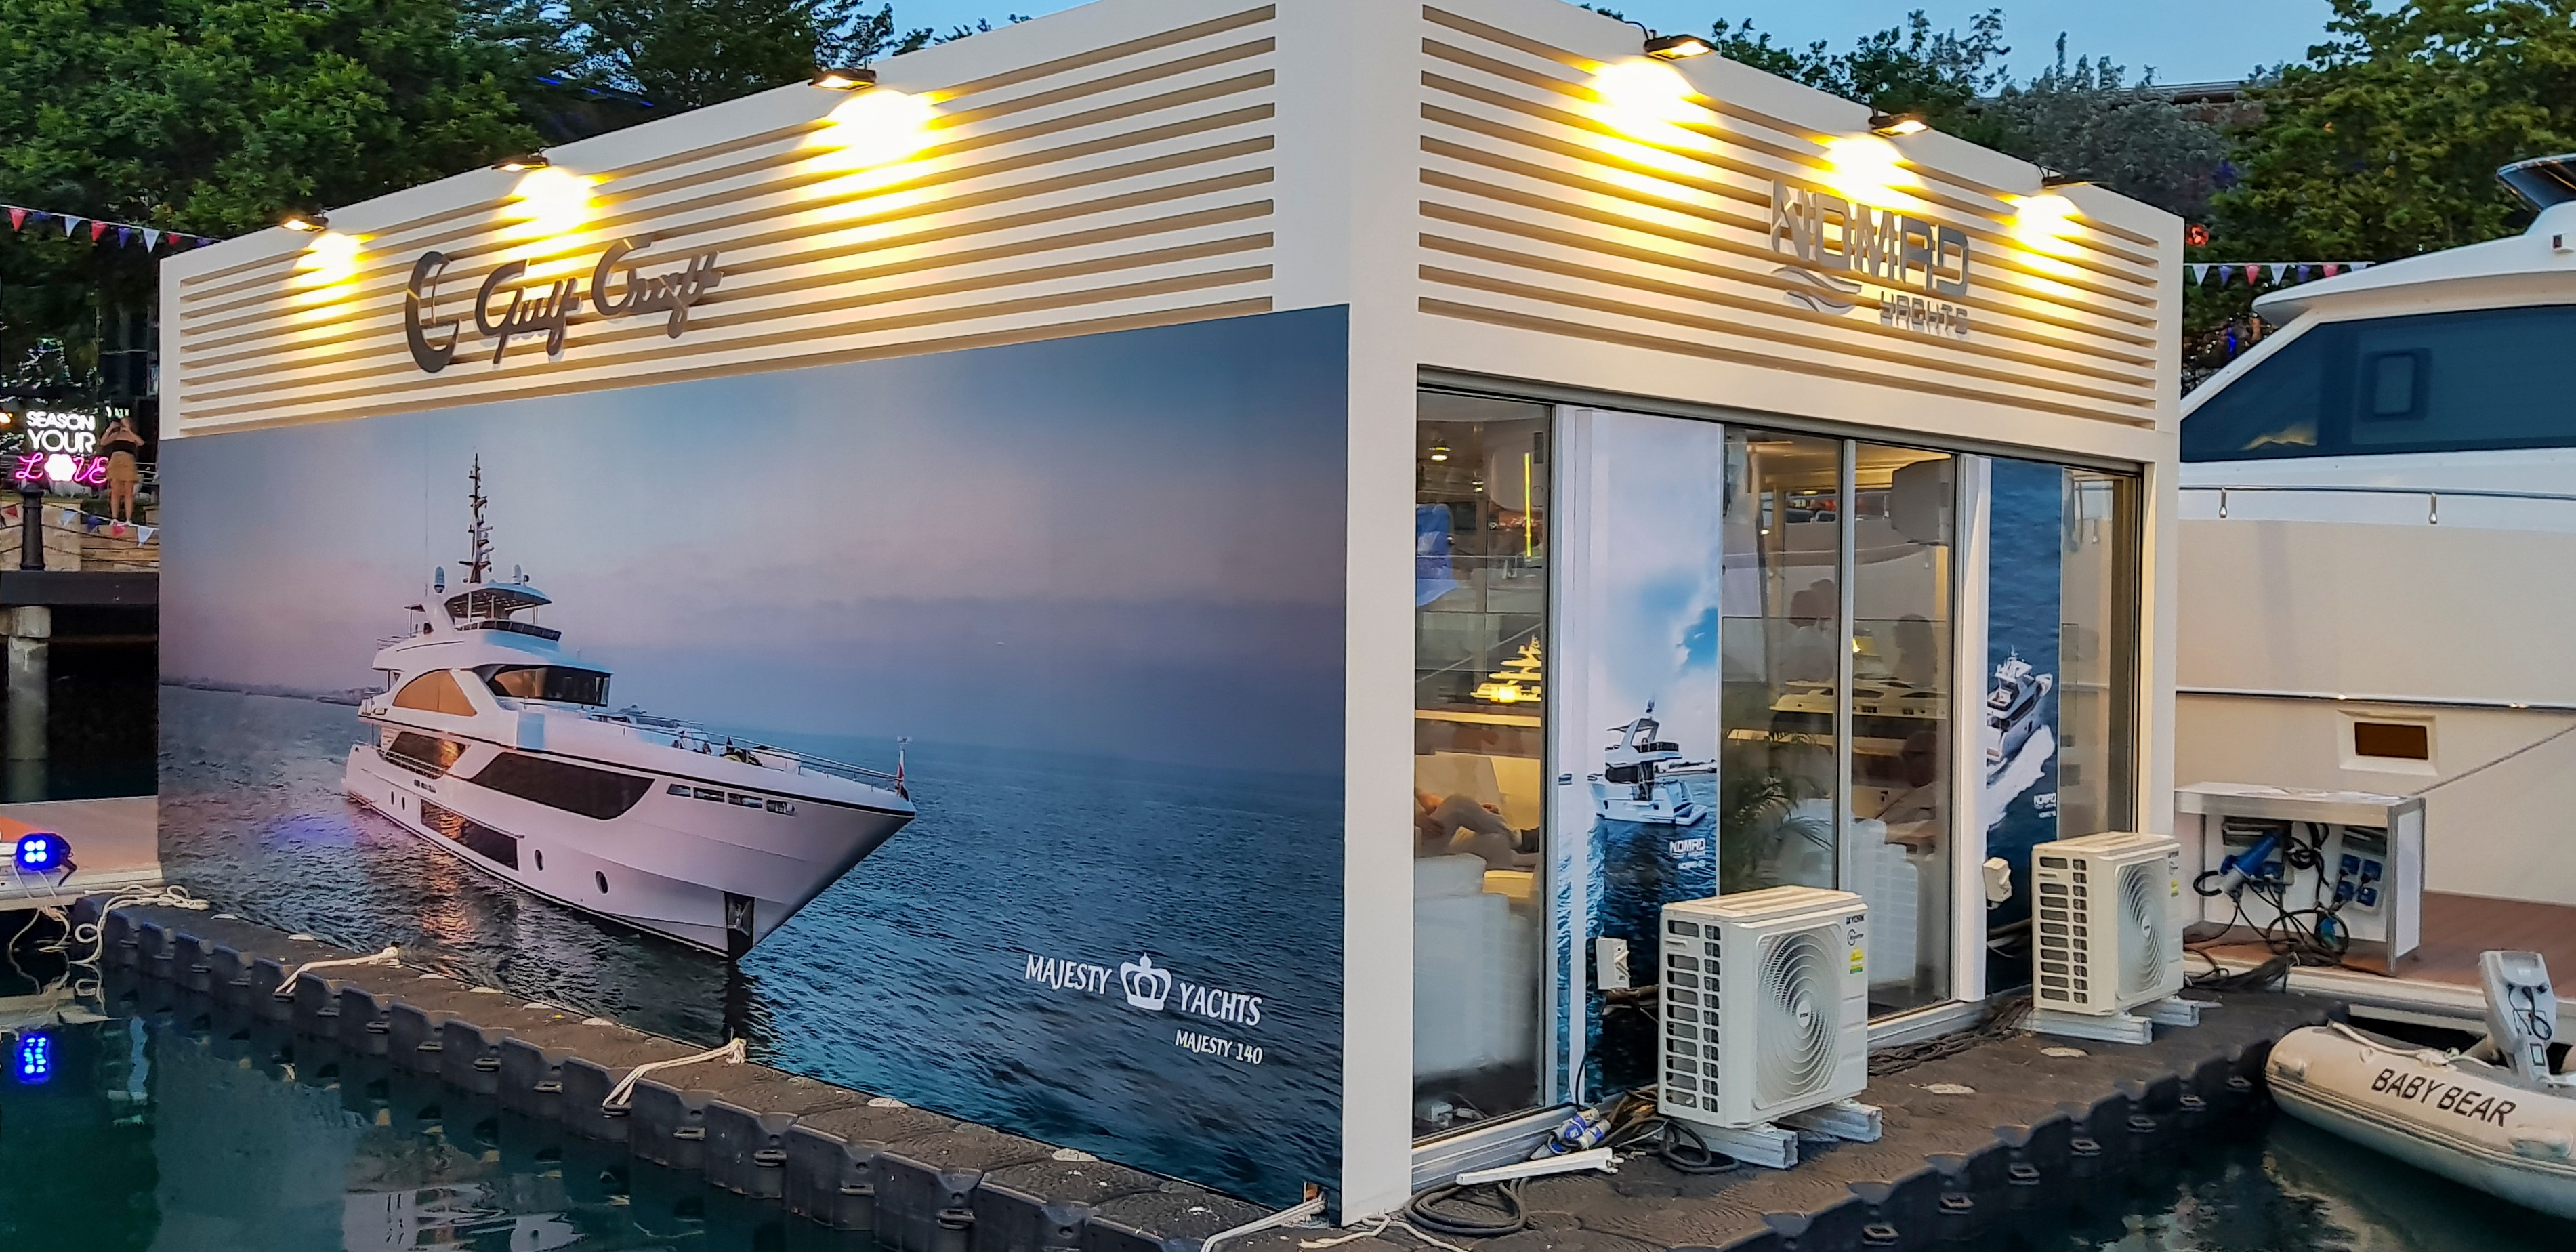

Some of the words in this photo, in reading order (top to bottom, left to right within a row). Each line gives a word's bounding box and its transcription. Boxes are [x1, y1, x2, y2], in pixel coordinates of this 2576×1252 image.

[1770, 180, 1969, 297] NOMAD
[476, 258, 582, 364] Gulf
[591, 234, 724, 339] Craft
[1880, 291, 1968, 335] YACHTS
[26, 410, 96, 432] SEASON
[27, 428, 97, 453] YOUR
[1669, 837, 1706, 854] NOMAD
[1024, 953, 1113, 995] MAJESTY
[1179, 982, 1263, 1026] YACHTS
[1175, 1029, 1233, 1058] MAJESTY
[1235, 1043, 1263, 1065] 140
[2371, 1068, 2444, 1105] BABY
[2437, 1085, 2517, 1127] BEAR
